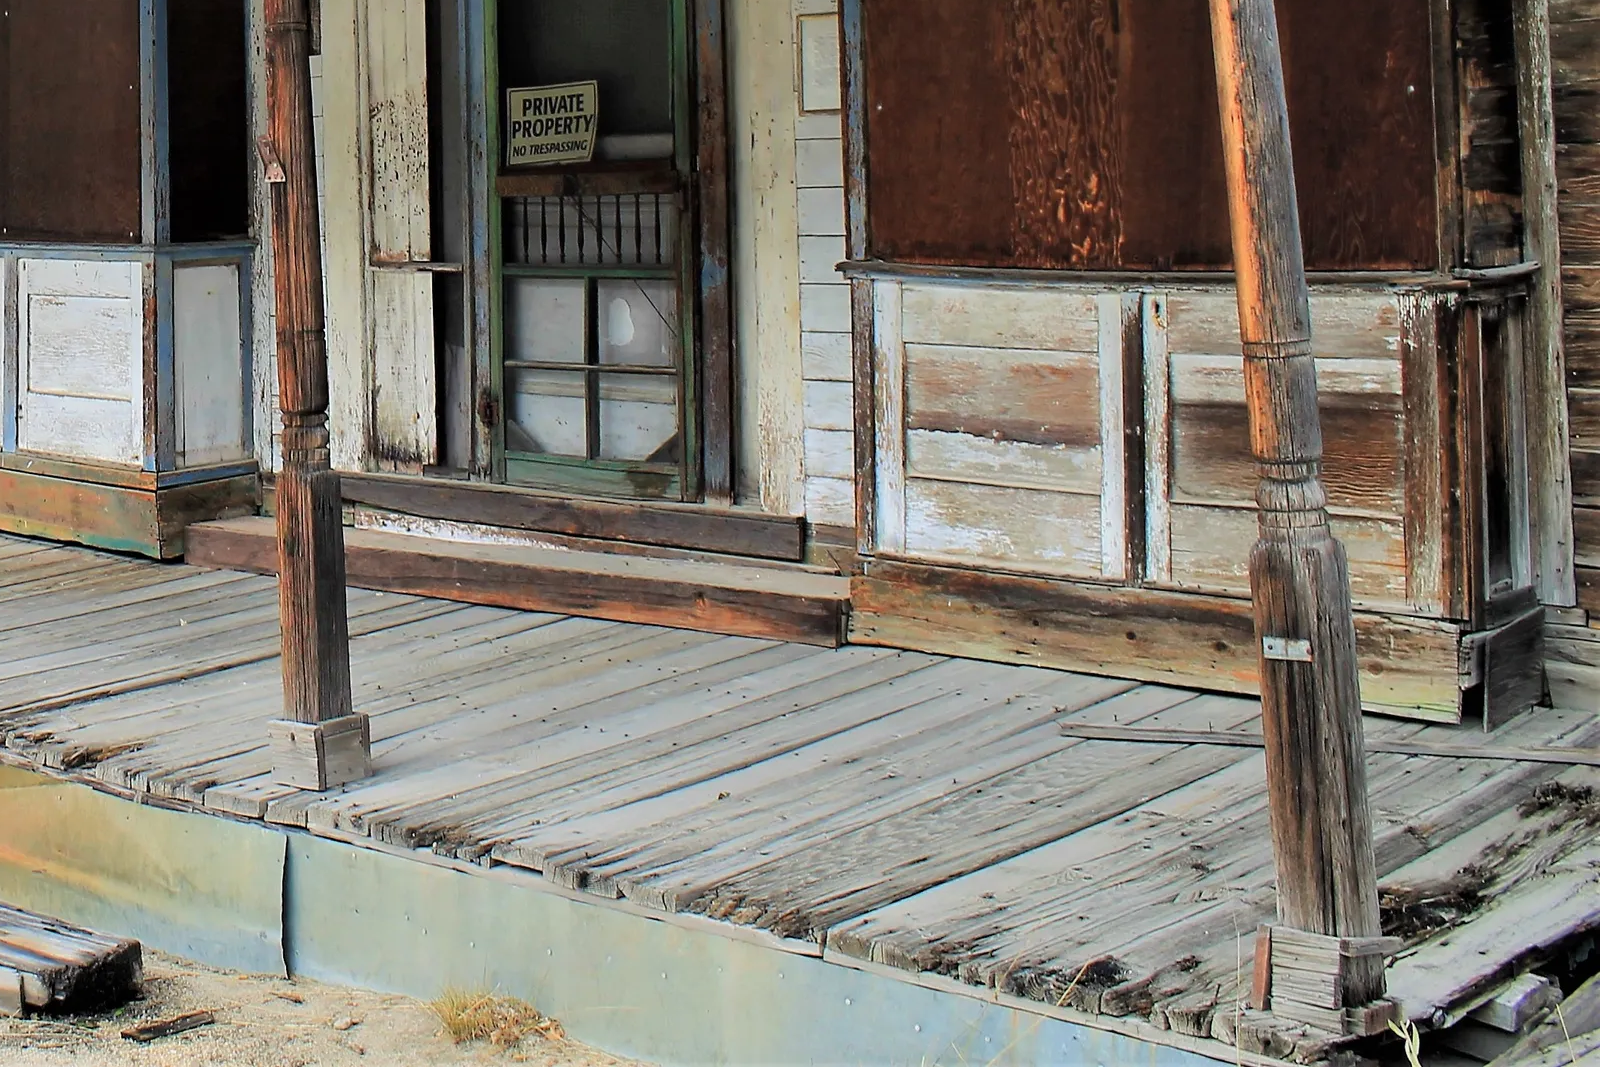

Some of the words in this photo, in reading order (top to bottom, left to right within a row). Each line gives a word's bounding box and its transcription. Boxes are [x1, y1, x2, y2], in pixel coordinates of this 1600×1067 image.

[522, 94, 584, 117] PRIVATE
[512, 115, 594, 139] PROPERTY
[512, 145, 527, 157] NO
[529, 140, 588, 155] TRESPASSING
